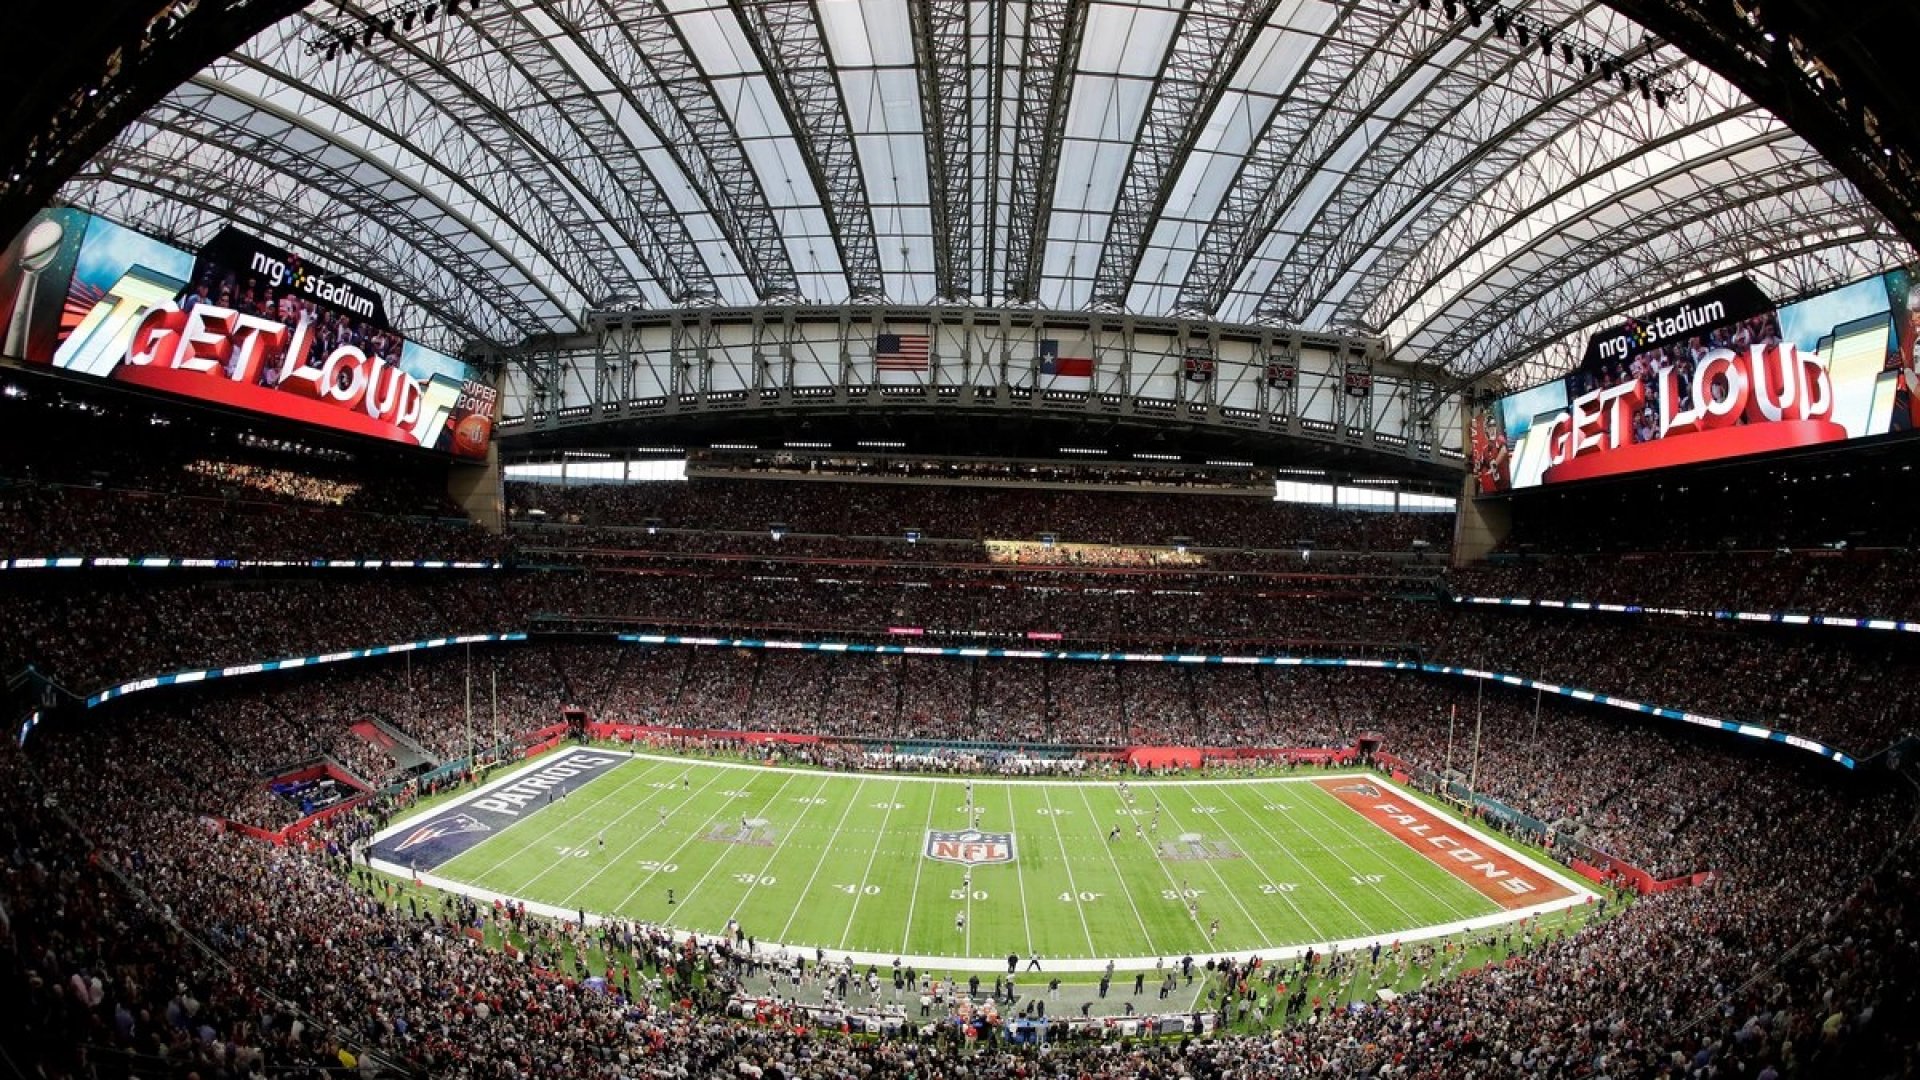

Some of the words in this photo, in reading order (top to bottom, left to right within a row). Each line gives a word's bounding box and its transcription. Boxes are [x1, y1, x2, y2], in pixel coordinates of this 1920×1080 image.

[251, 251, 285, 286] nrg
[303, 275, 374, 318] stadium
[1599, 335, 1628, 359] nrg
[1646, 301, 1725, 343] stadium
[125, 297, 286, 382] GET
[279, 318, 422, 428] LOUD
[461, 380, 497, 402] SUPER
[1547, 379, 1644, 467] GET
[1659, 343, 1833, 439] LOUD
[470, 754, 616, 816] PATRIOTS
[936, 841, 1005, 860] NFL
[1373, 803, 1537, 894] FALCONS
[840, 884, 881, 895] 40
[949, 889, 988, 900] 50
[1057, 891, 1096, 901] 40
